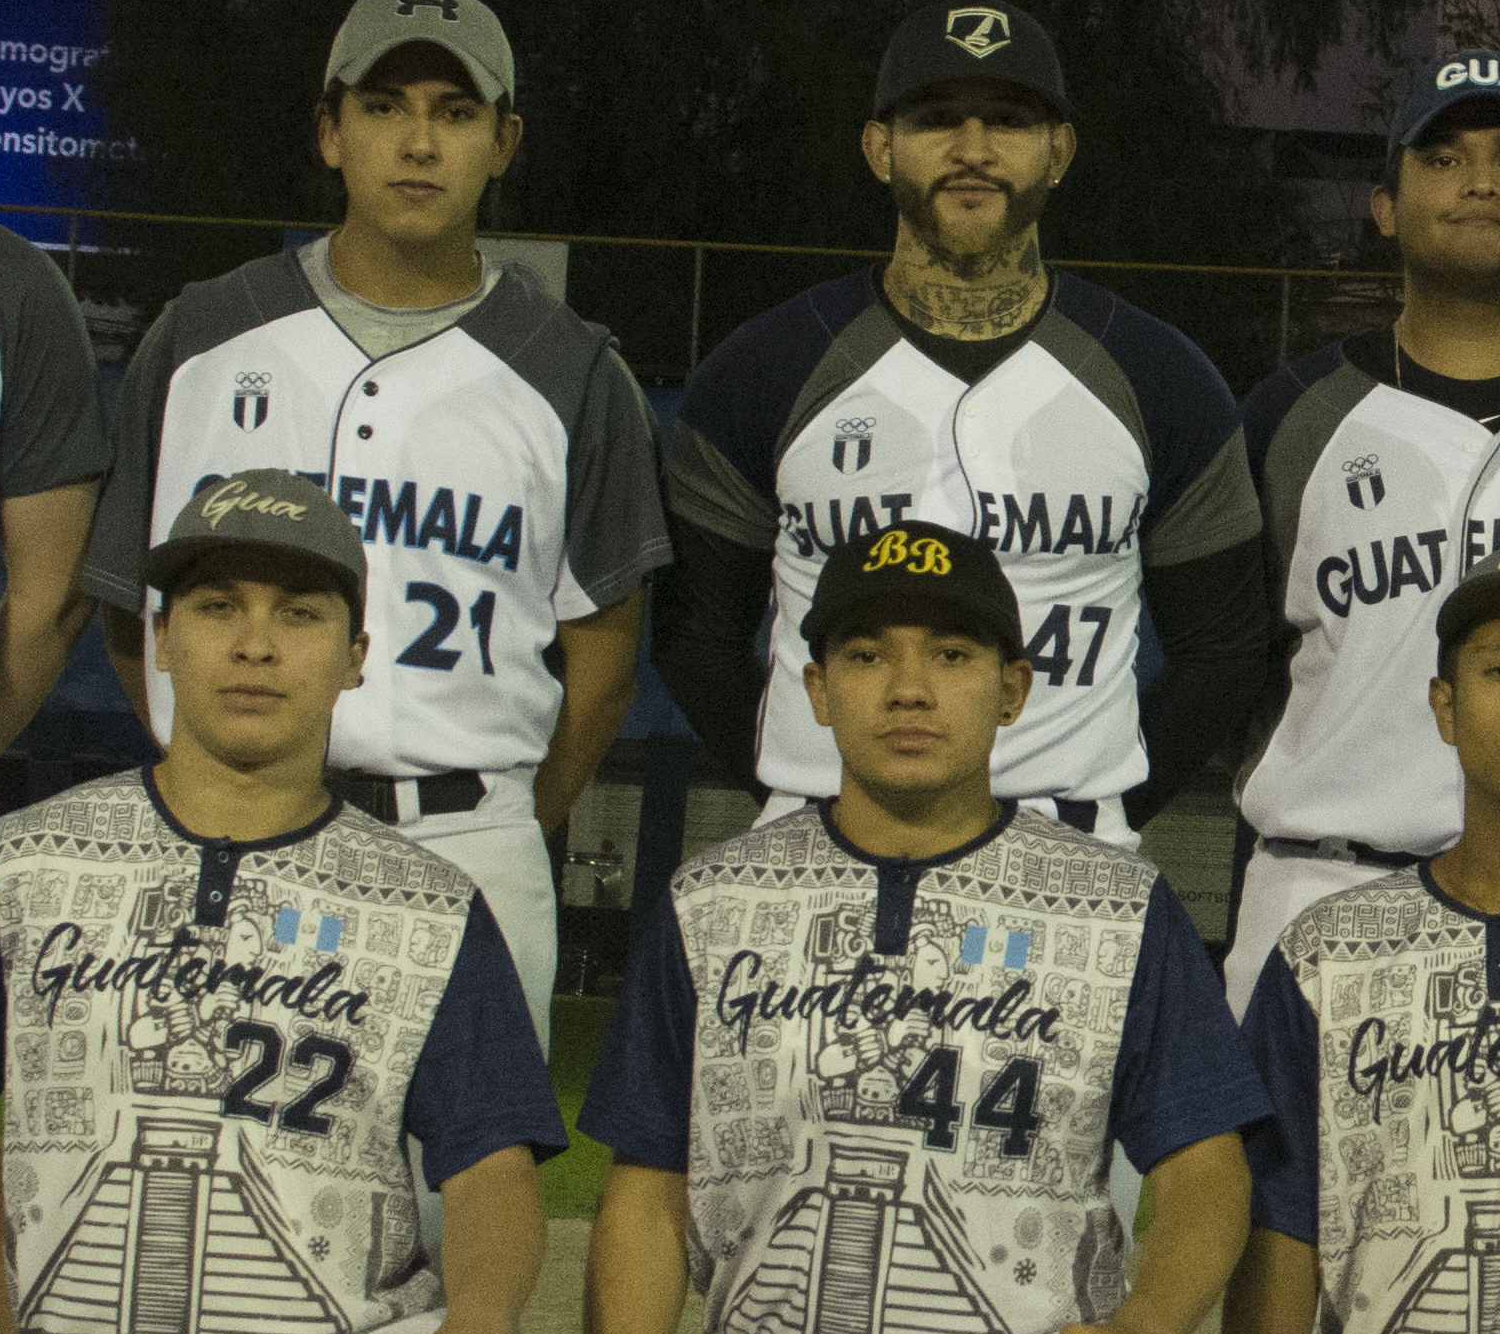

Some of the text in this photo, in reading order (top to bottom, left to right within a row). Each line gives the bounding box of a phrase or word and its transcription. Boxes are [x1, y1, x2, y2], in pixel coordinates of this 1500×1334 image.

[61, 82, 85, 113] X
[201, 480, 308, 531] Gua
[862, 530, 953, 577] BB
[395, 580, 496, 676] 21
[1025, 603, 1112, 687] 47
[31, 921, 370, 1032] Guatemala
[717, 948, 1062, 1046] Guatemala
[220, 1020, 354, 1138] 22
[897, 1043, 1045, 1158] 44
